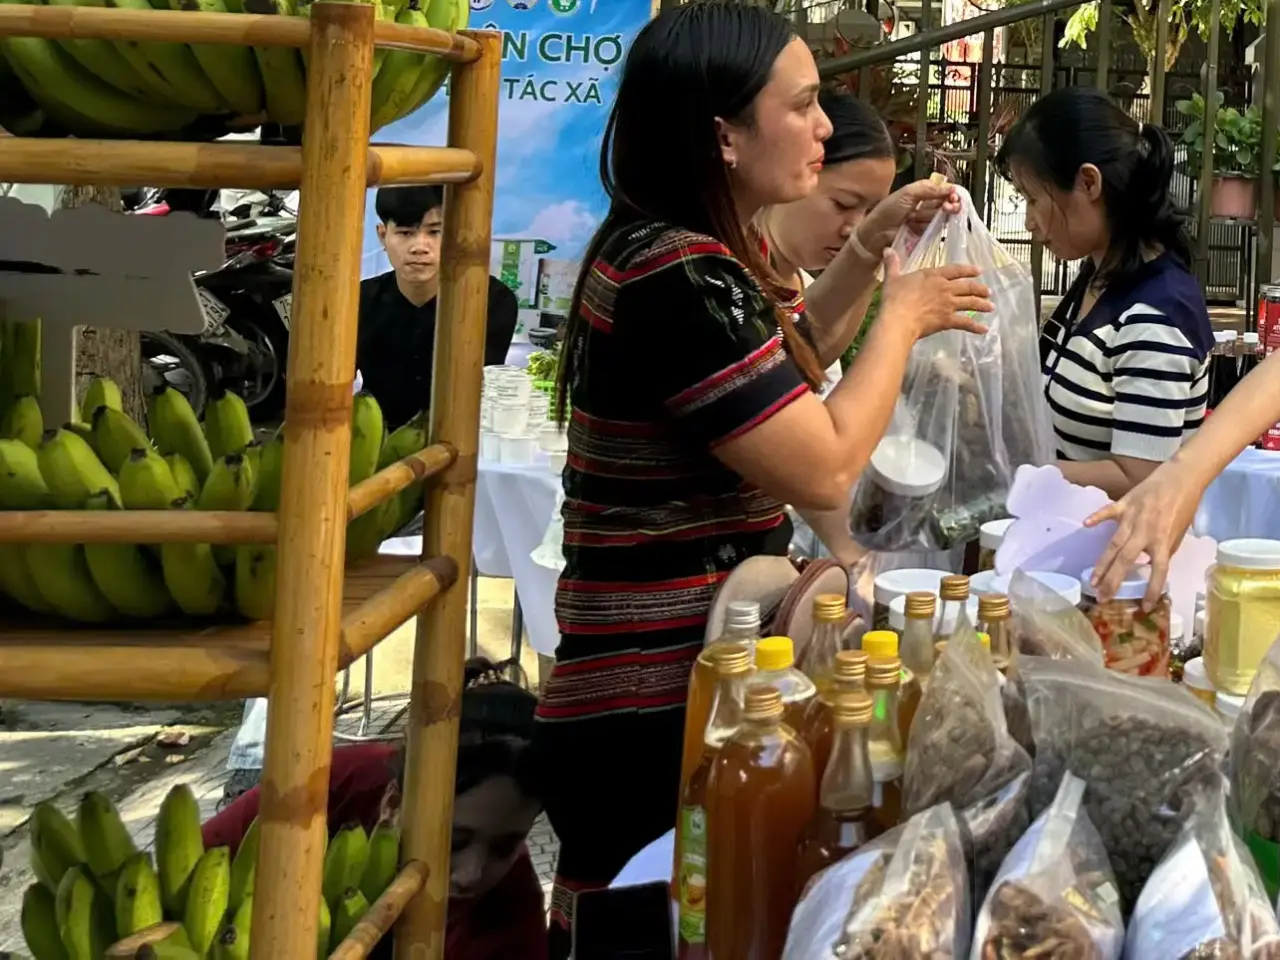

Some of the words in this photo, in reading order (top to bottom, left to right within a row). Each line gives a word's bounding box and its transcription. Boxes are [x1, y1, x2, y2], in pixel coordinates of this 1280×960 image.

[538, 32, 623, 72] CHỢ
[504, 74, 558, 102] TÁC
[564, 77, 602, 104] XÃ
